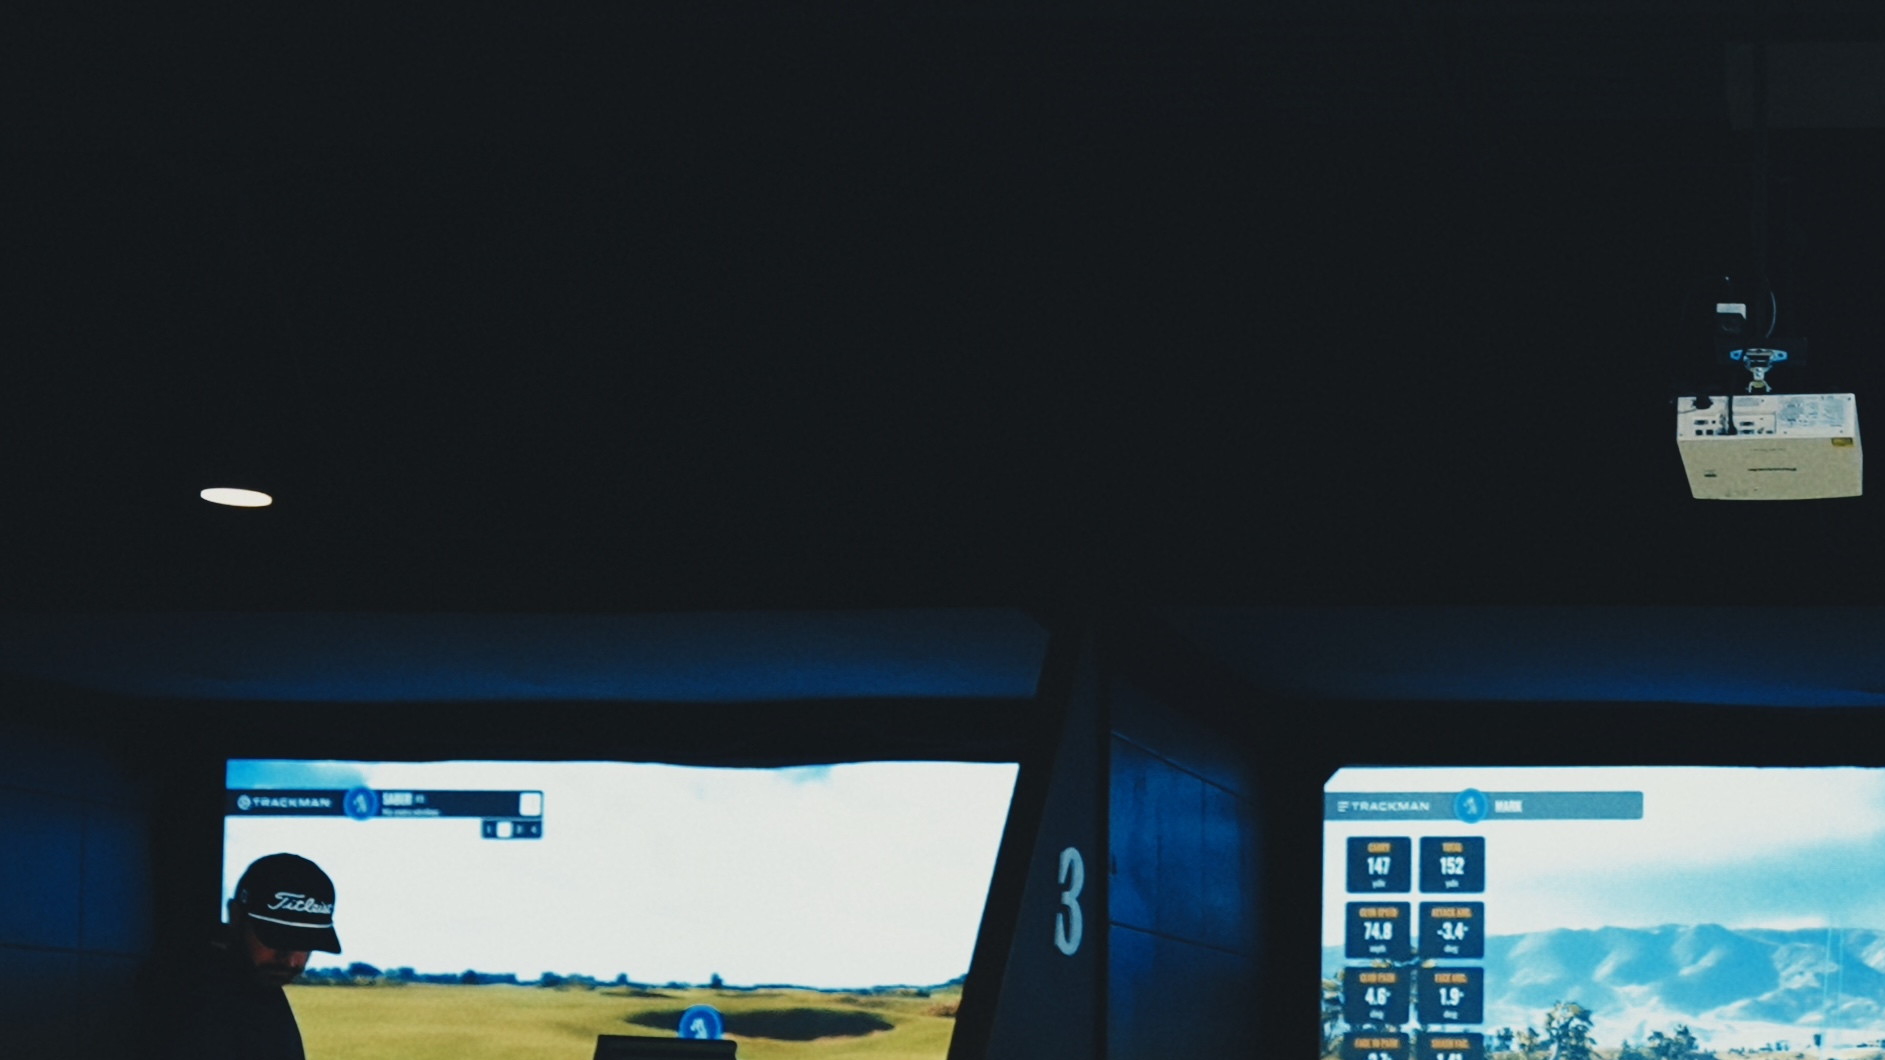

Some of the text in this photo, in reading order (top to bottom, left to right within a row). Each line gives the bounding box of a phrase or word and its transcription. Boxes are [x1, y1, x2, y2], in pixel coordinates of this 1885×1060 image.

[252, 797, 332, 807] TRACKMAN
[1352, 802, 1430, 811] TRACKMAN
[1367, 857, 1390, 875] 147
[1440, 857, 1464, 875] 152
[1054, 847, 1085, 957] 3
[1364, 921, 1392, 940] 74.8
